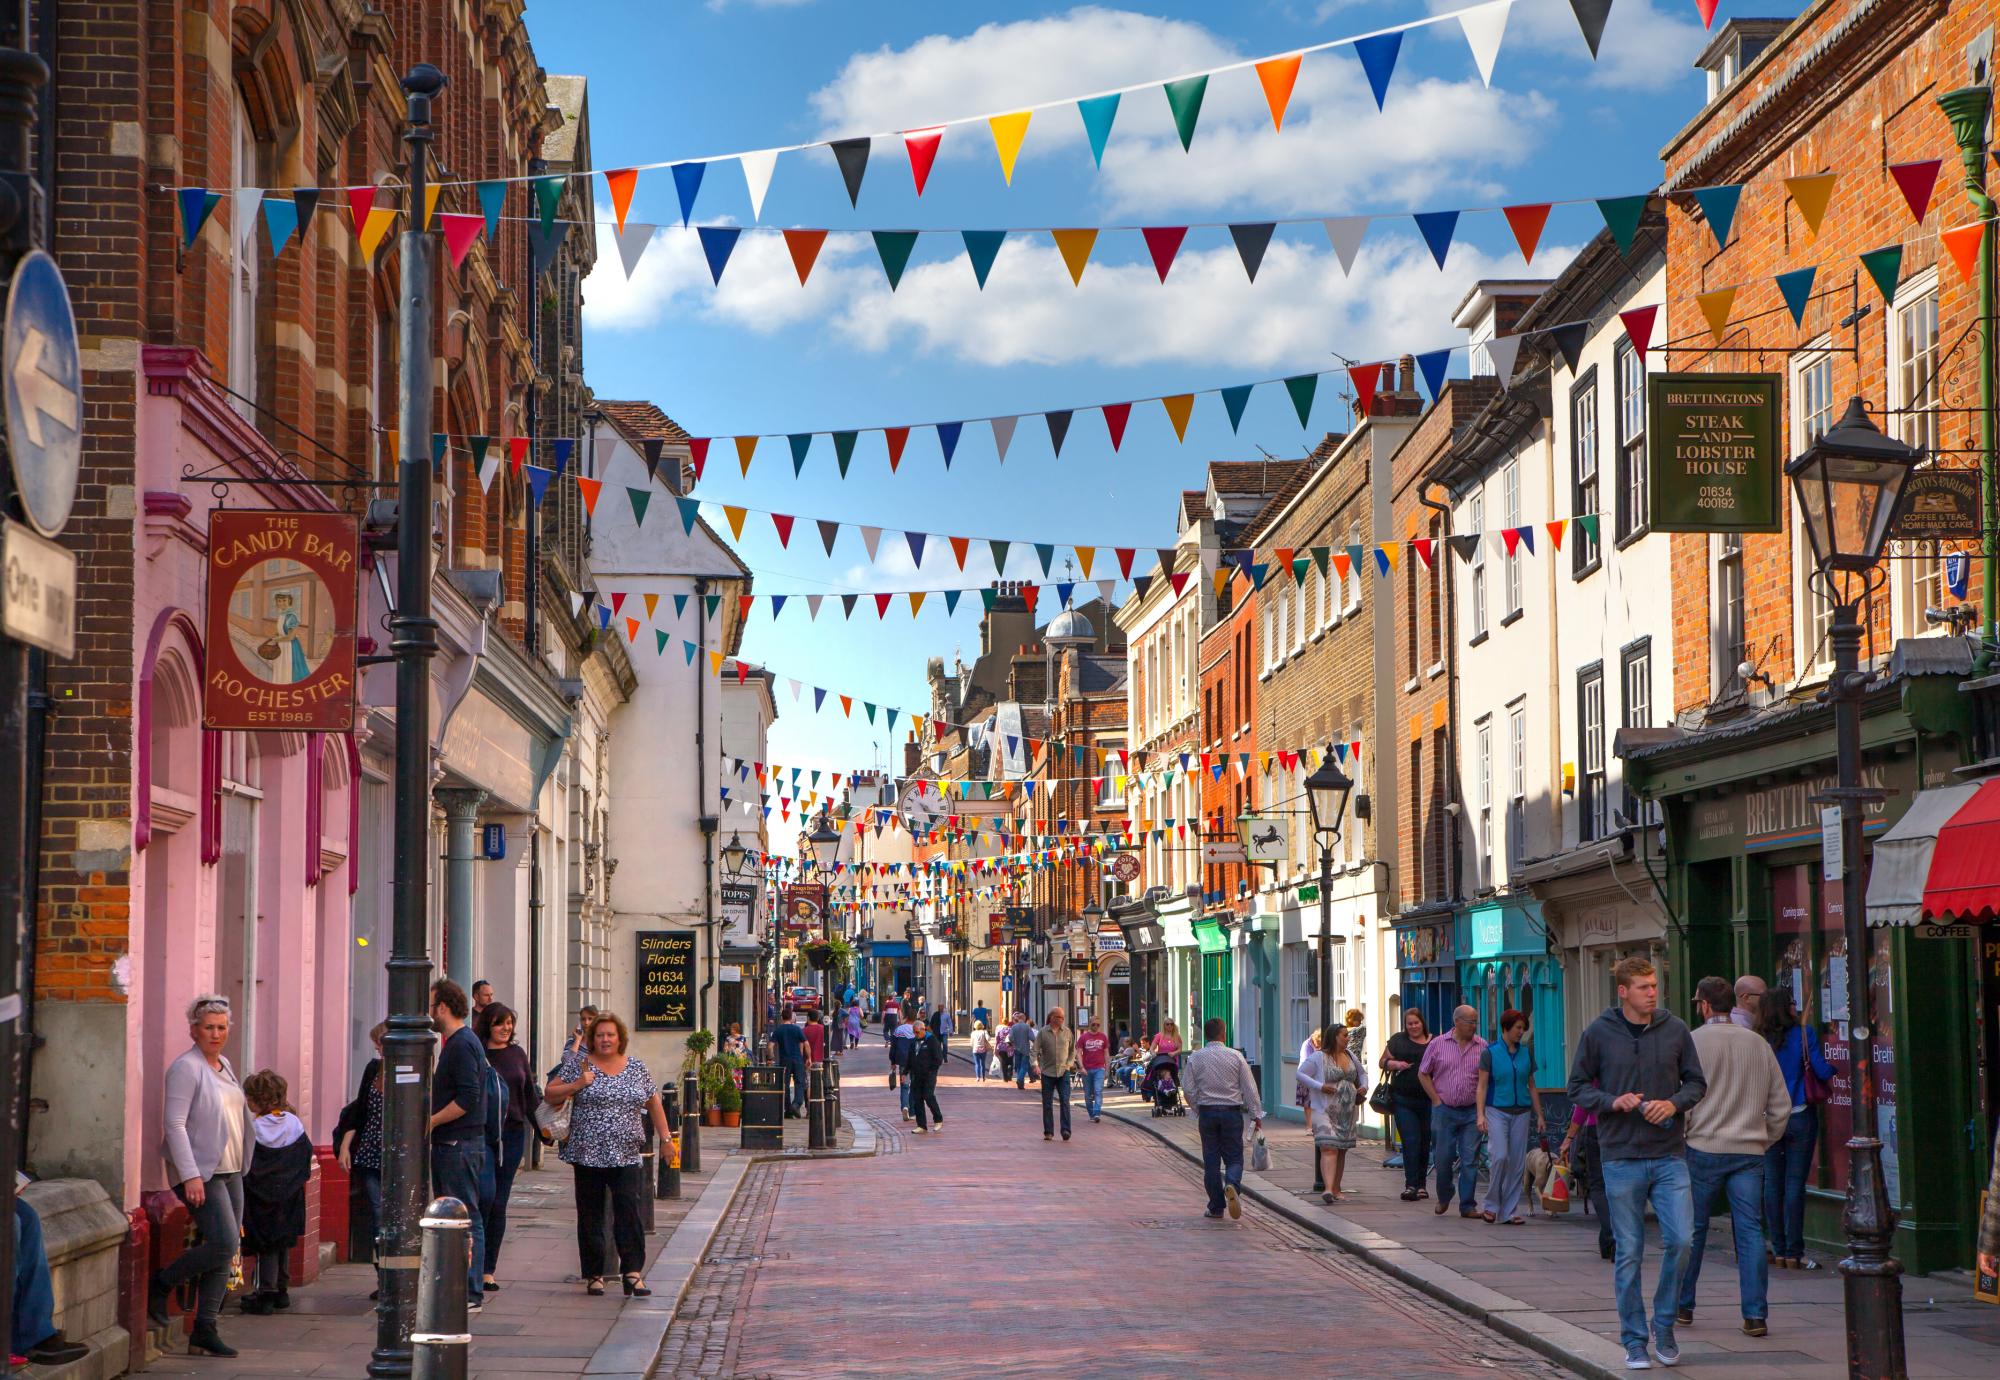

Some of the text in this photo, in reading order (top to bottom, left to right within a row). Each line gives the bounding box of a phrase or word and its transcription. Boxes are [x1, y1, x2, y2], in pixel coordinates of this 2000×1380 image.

[1667, 394, 1764, 404] BRETTINGTONS
[1686, 415, 1744, 429] STEAK
[1700, 432, 1732, 443] AND
[1676, 446, 1756, 459] LOBSTER
[1686, 461, 1747, 475] HOUSE
[1700, 486, 1732, 497] 01634
[1697, 498, 1735, 509] 400192
[1904, 513, 1937, 521] COFFEE
[266, 517, 299, 529] THE
[215, 530, 352, 573] CANDY BAR
[211, 669, 350, 708] ROCHESTER
[248, 711, 313, 722] EST 1985
[722, 889, 751, 899] TOPES
[1927, 926, 1970, 937] COFFEE
[641, 939, 692, 950] Slinders
[646, 954, 687, 965] Florist
[648, 971, 684, 982] 01634
[645, 984, 687, 995] 846244
[645, 1013, 677, 1022] Interflora
